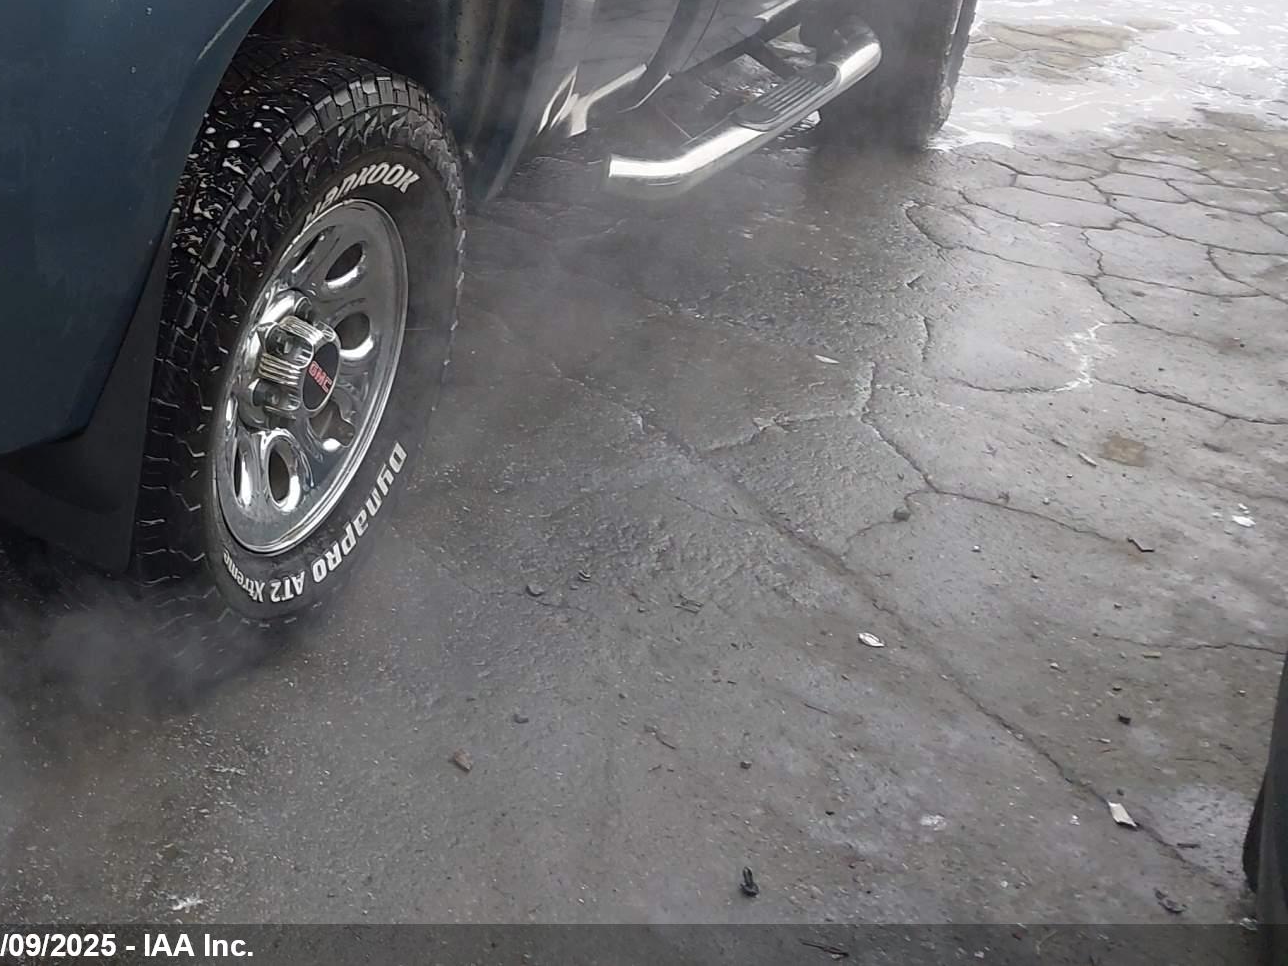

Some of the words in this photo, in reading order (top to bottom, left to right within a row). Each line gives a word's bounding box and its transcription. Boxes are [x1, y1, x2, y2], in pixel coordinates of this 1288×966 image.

[308, 360, 333, 394] GMC
[223, 548, 266, 603] Xtreme
[270, 570, 306, 603] AT2
